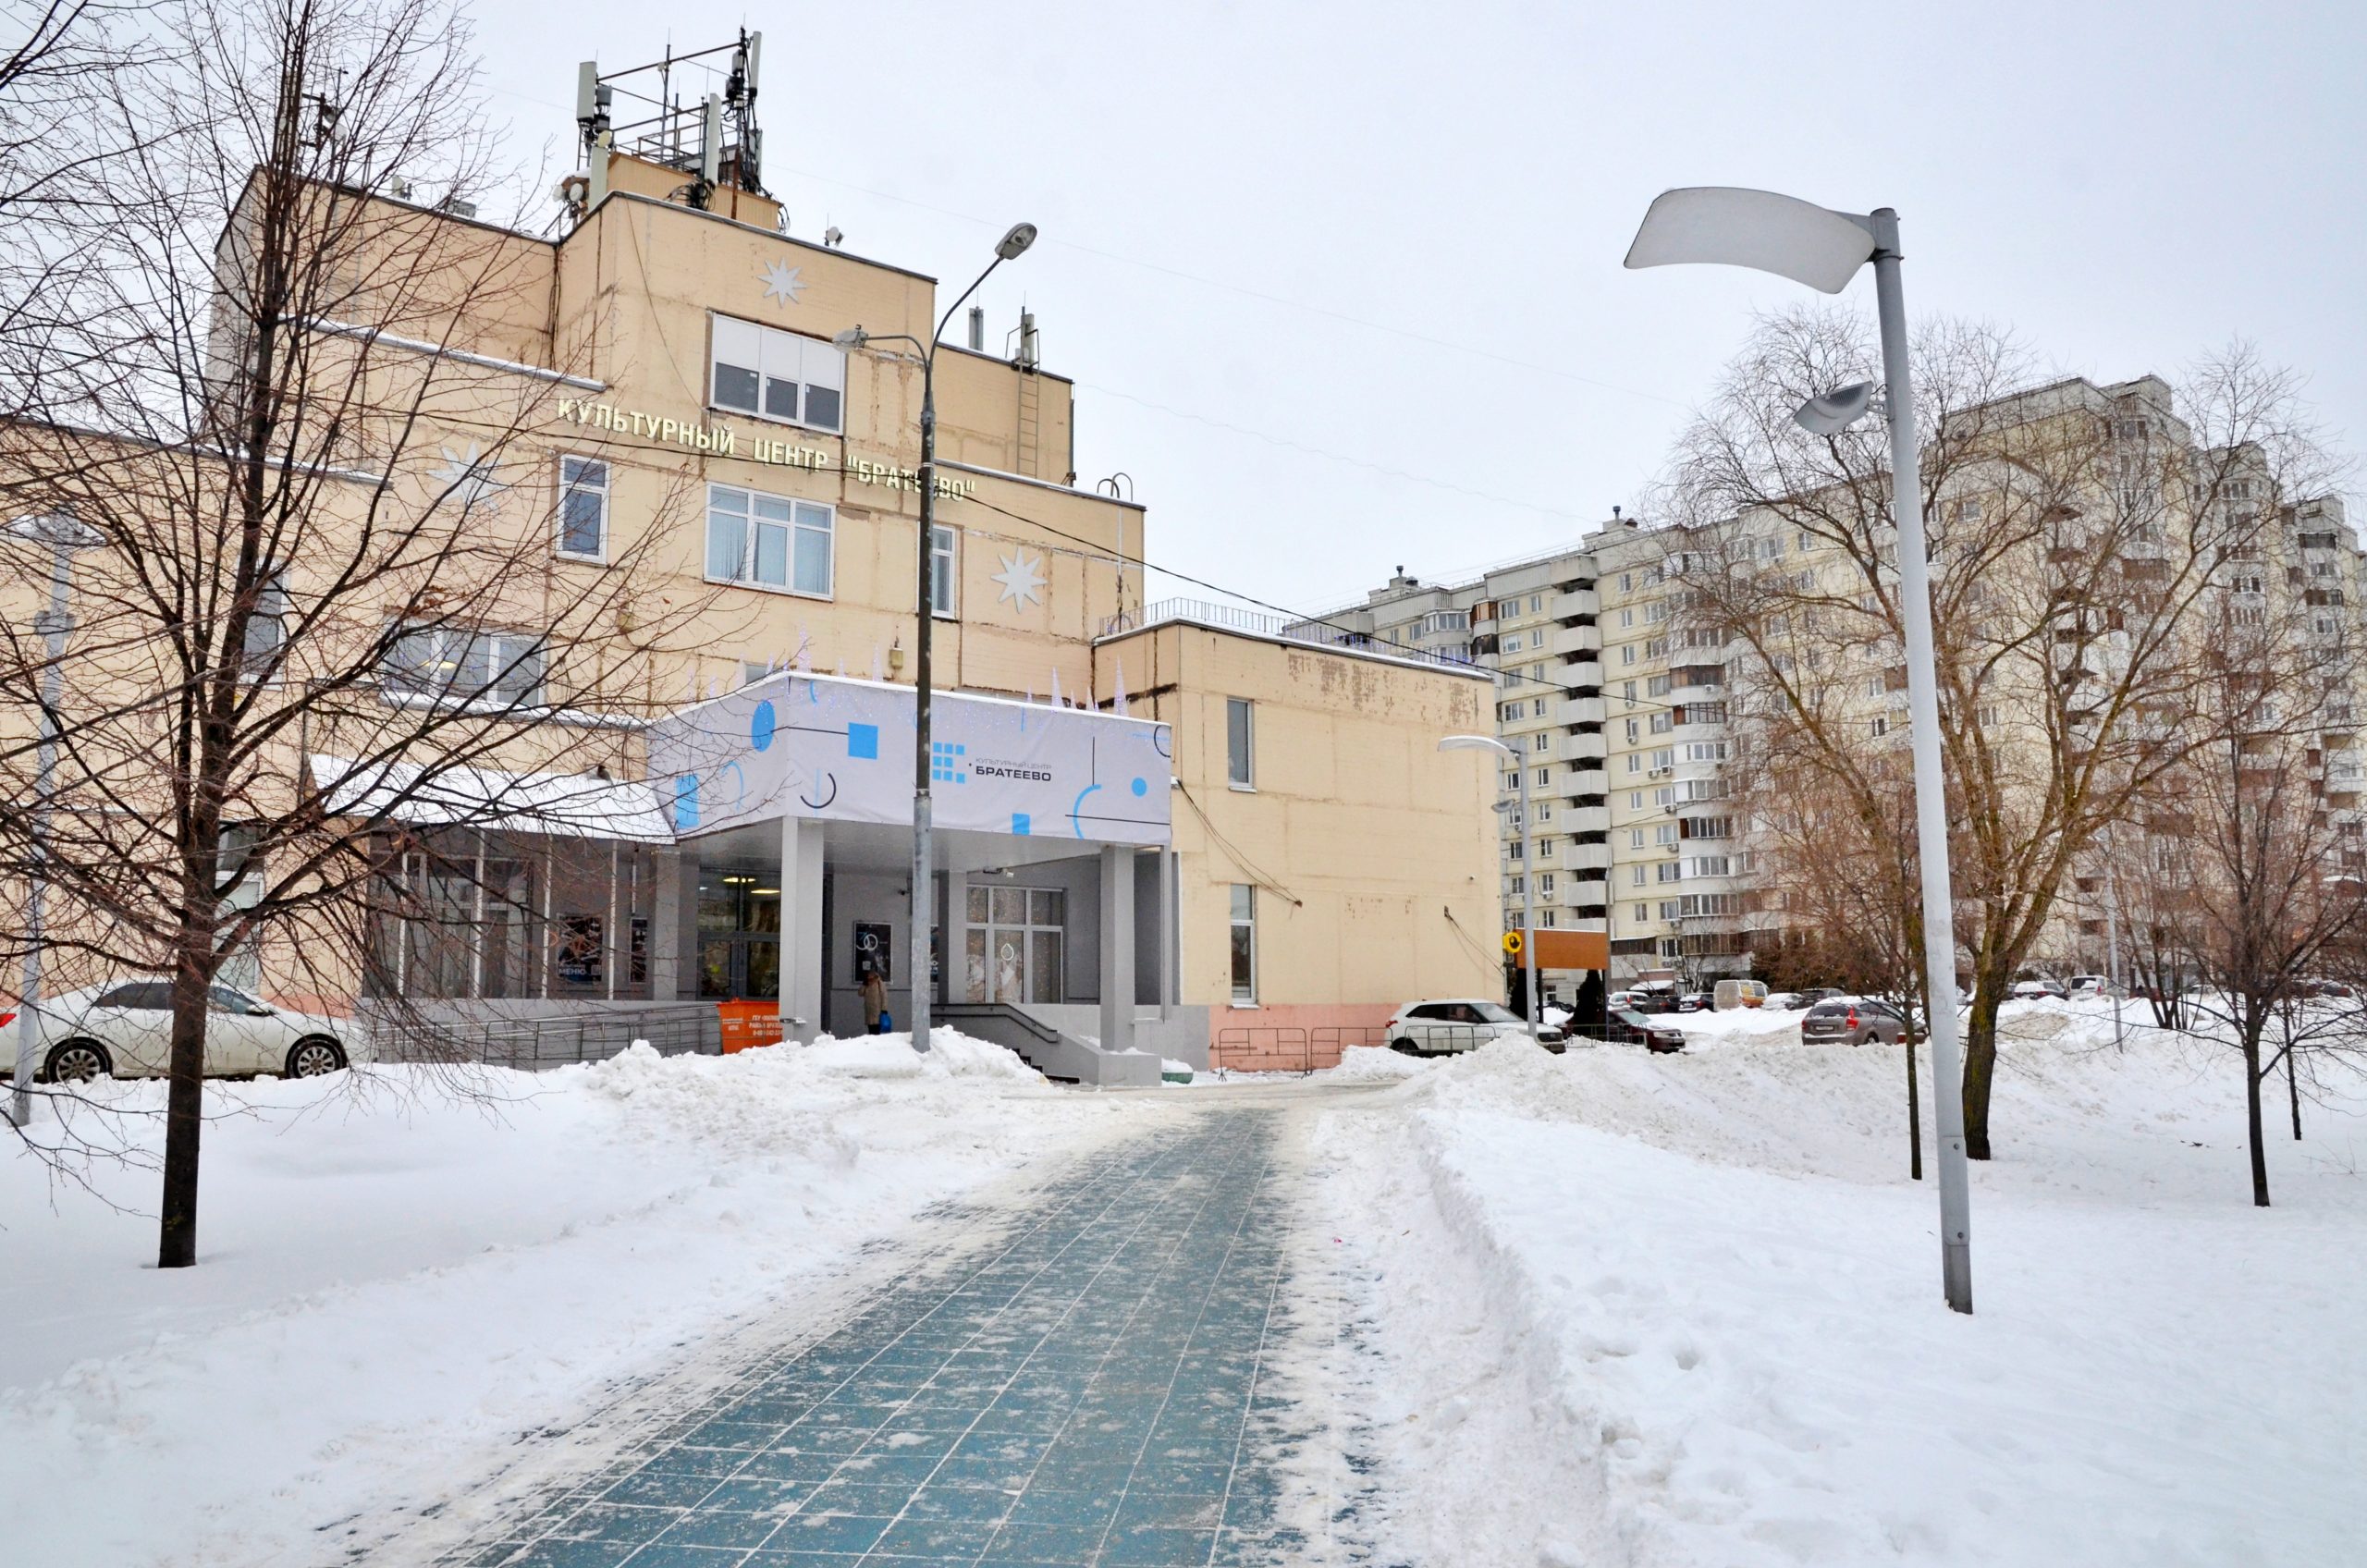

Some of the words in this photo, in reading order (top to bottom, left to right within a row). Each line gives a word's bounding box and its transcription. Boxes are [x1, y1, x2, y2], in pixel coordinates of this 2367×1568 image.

[558, 398, 735, 455] КУЛЬТУРНЫЙ
[754, 437, 828, 472] ЦЕНТР
[847, 454, 975, 502] "БРАТЕВО"
[975, 766, 1051, 781] БРАТЕЕВО
